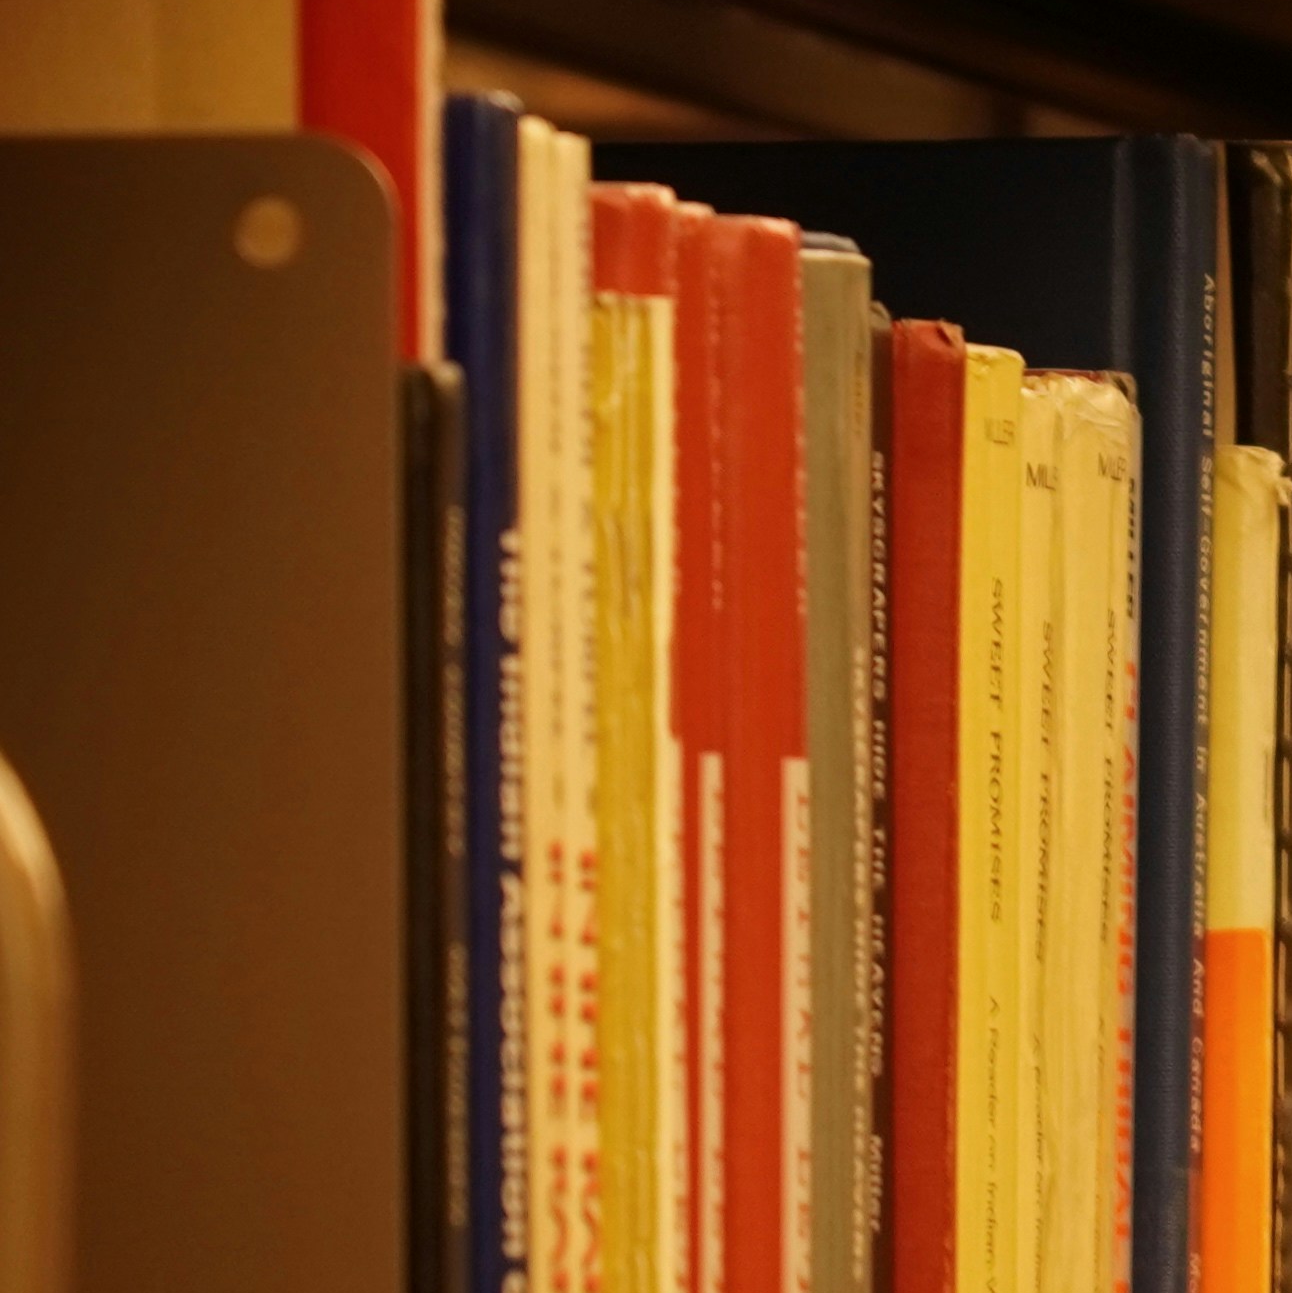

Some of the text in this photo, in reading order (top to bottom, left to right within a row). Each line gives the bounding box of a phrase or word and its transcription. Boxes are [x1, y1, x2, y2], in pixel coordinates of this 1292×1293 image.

[1201, 273, 1215, 437] Aboriginal
[1197, 455, 1214, 725] Self-Government
[870, 451, 888, 1078] SKYSCRAPERS HIDE THE HEAVENS
[989, 577, 1005, 924] SWEET PROMISES
[1035, 619, 1055, 964] SWEET PROMISES
[1099, 607, 1116, 946] SWEET PROMISES
[1193, 792, 1207, 940] Australia
[1190, 1035, 1205, 1154] Canada
[1191, 958, 1205, 1017] And
